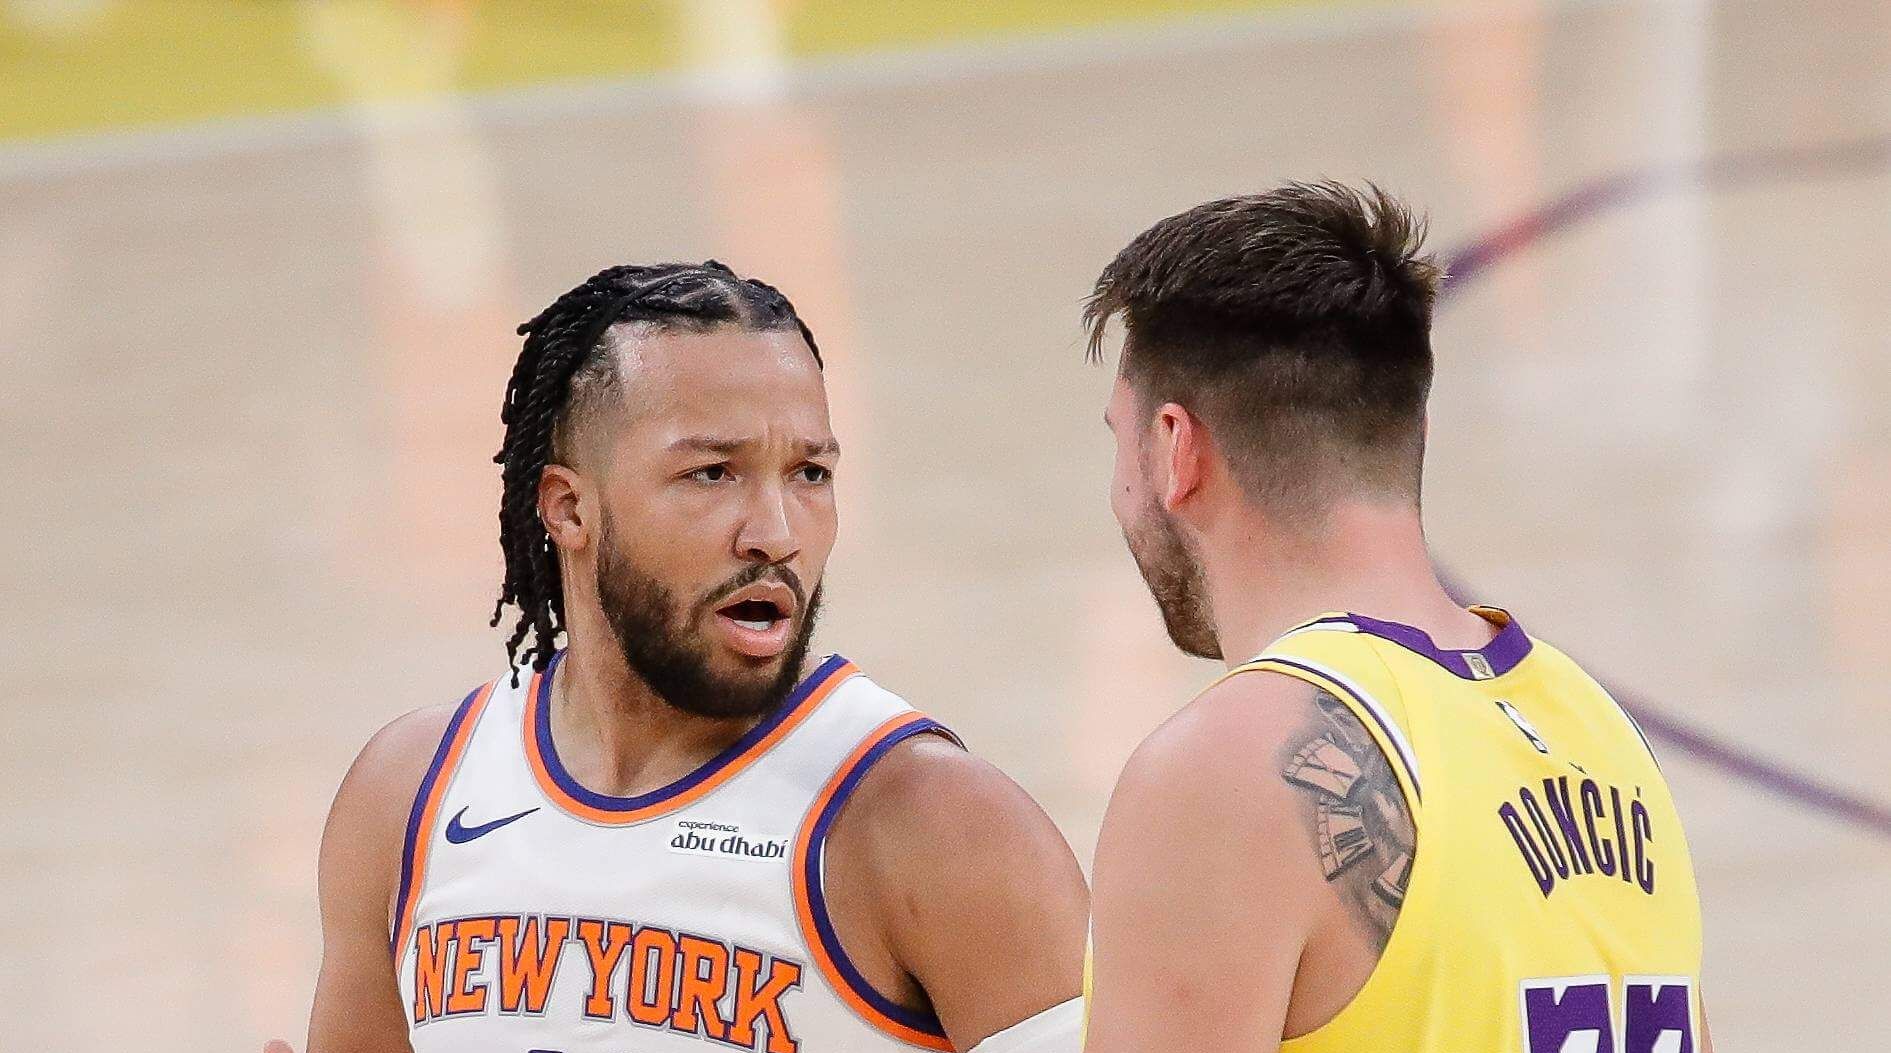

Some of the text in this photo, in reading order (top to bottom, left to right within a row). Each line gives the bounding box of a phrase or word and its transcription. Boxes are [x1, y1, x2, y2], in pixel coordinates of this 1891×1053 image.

[671, 831, 788, 858] abu dhabi
[678, 820, 739, 833] experience
[1498, 762, 1655, 899] DONČIĆ
[414, 912, 571, 1028] NEW
